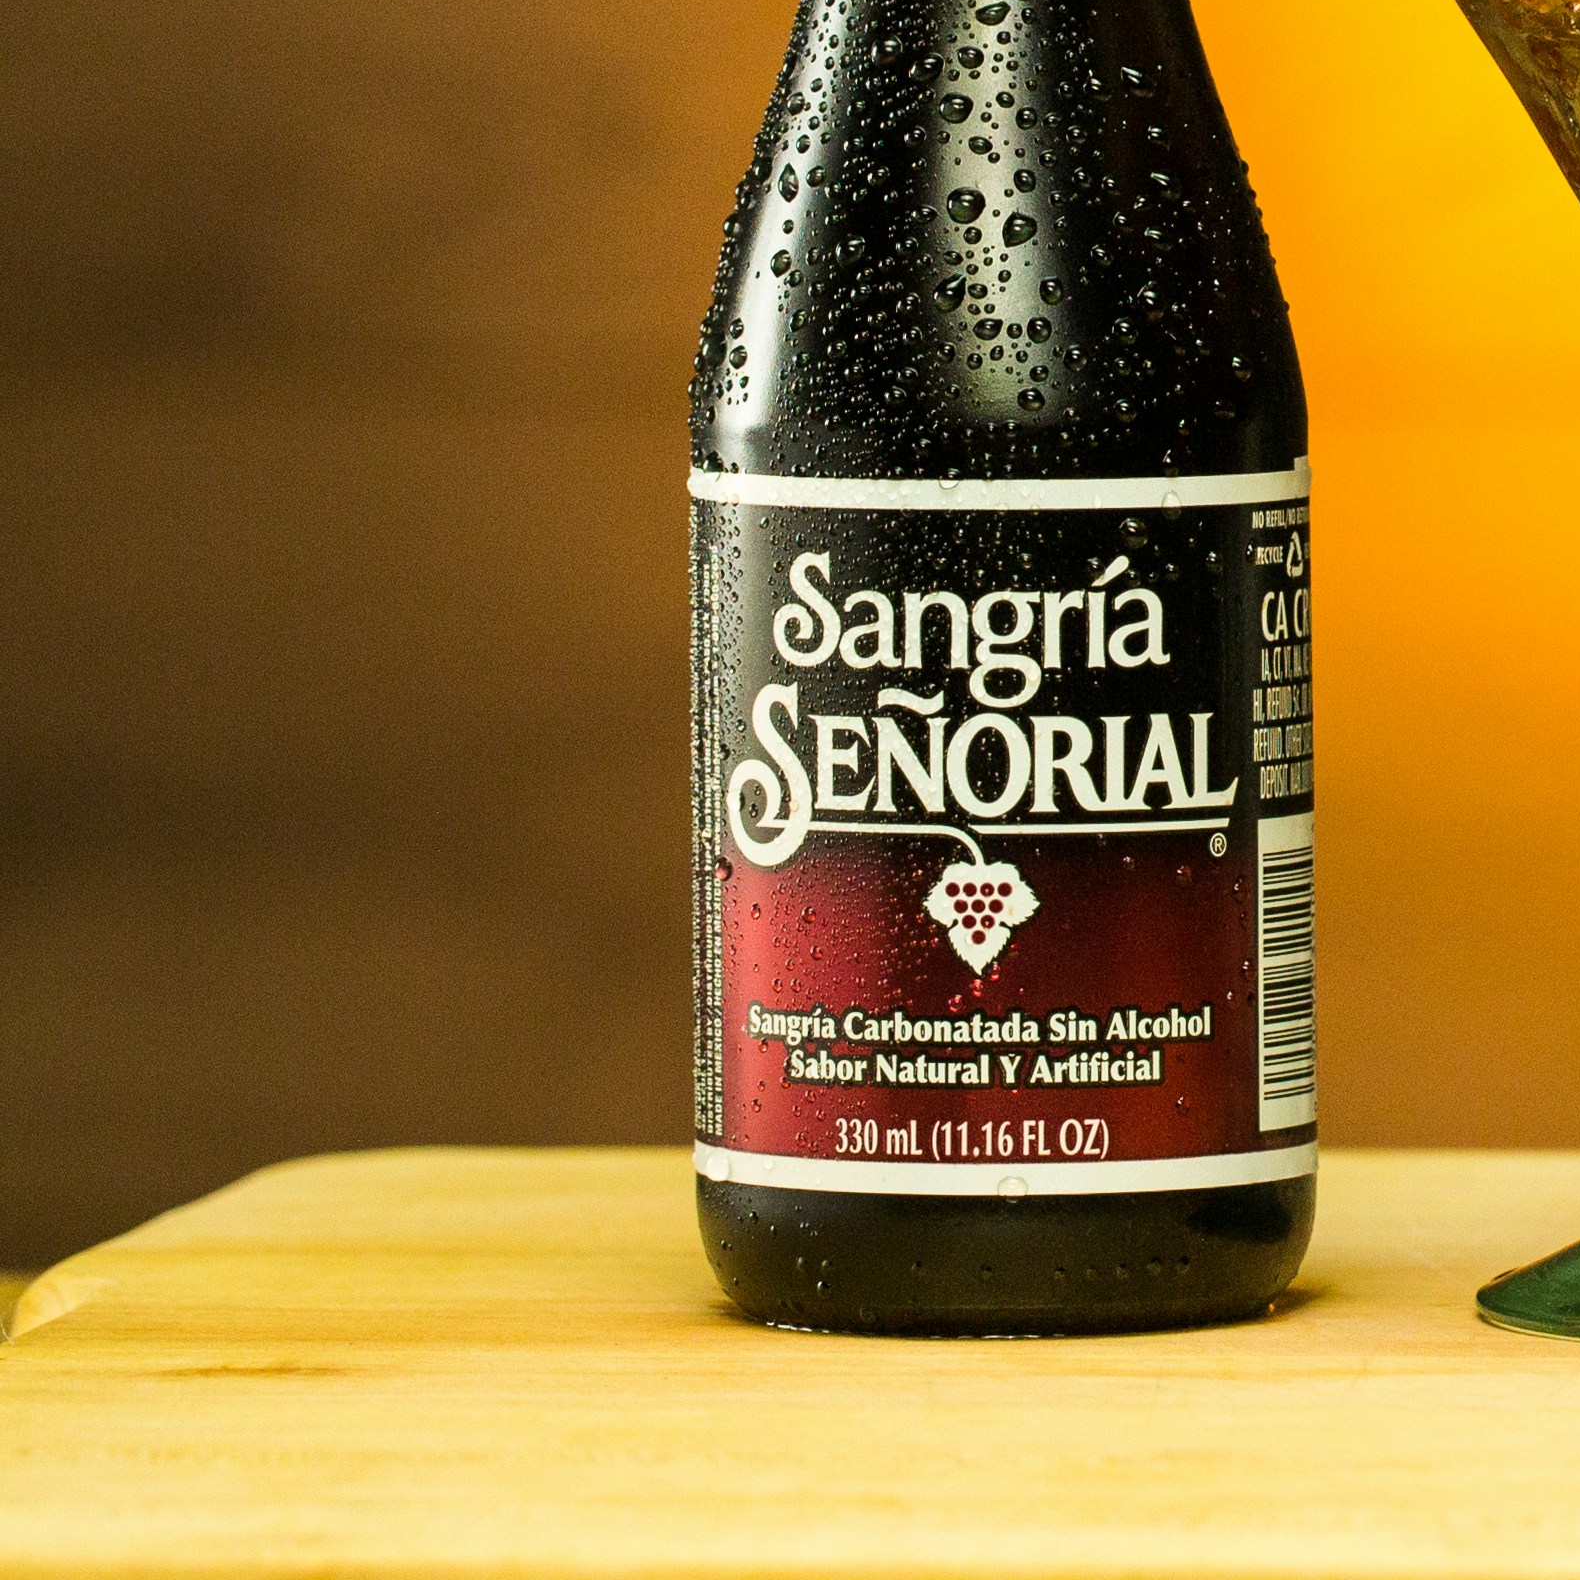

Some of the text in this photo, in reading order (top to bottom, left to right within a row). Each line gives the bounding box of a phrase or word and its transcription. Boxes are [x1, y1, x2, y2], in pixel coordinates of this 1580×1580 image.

[1252, 510, 1264, 529] NO
[773, 551, 1170, 707] Sangría
[1261, 591, 1289, 641] CA
[728, 683, 1239, 867] SEÑORIAL
[713, 935, 722, 955] EN
[713, 957, 722, 1006] HECHO
[714, 1017, 722, 1074] MEXICO
[748, 1005, 1211, 1045] Sangría Carbonatada Sin Alcohol
[714, 1075, 723, 1092] IN
[790, 1049, 1161, 1084] Sabor Natural Y Artificial
[714, 1094, 723, 1136] MADE
[835, 1118, 1110, 1161] 330 mL (11.16 FL OZ)
